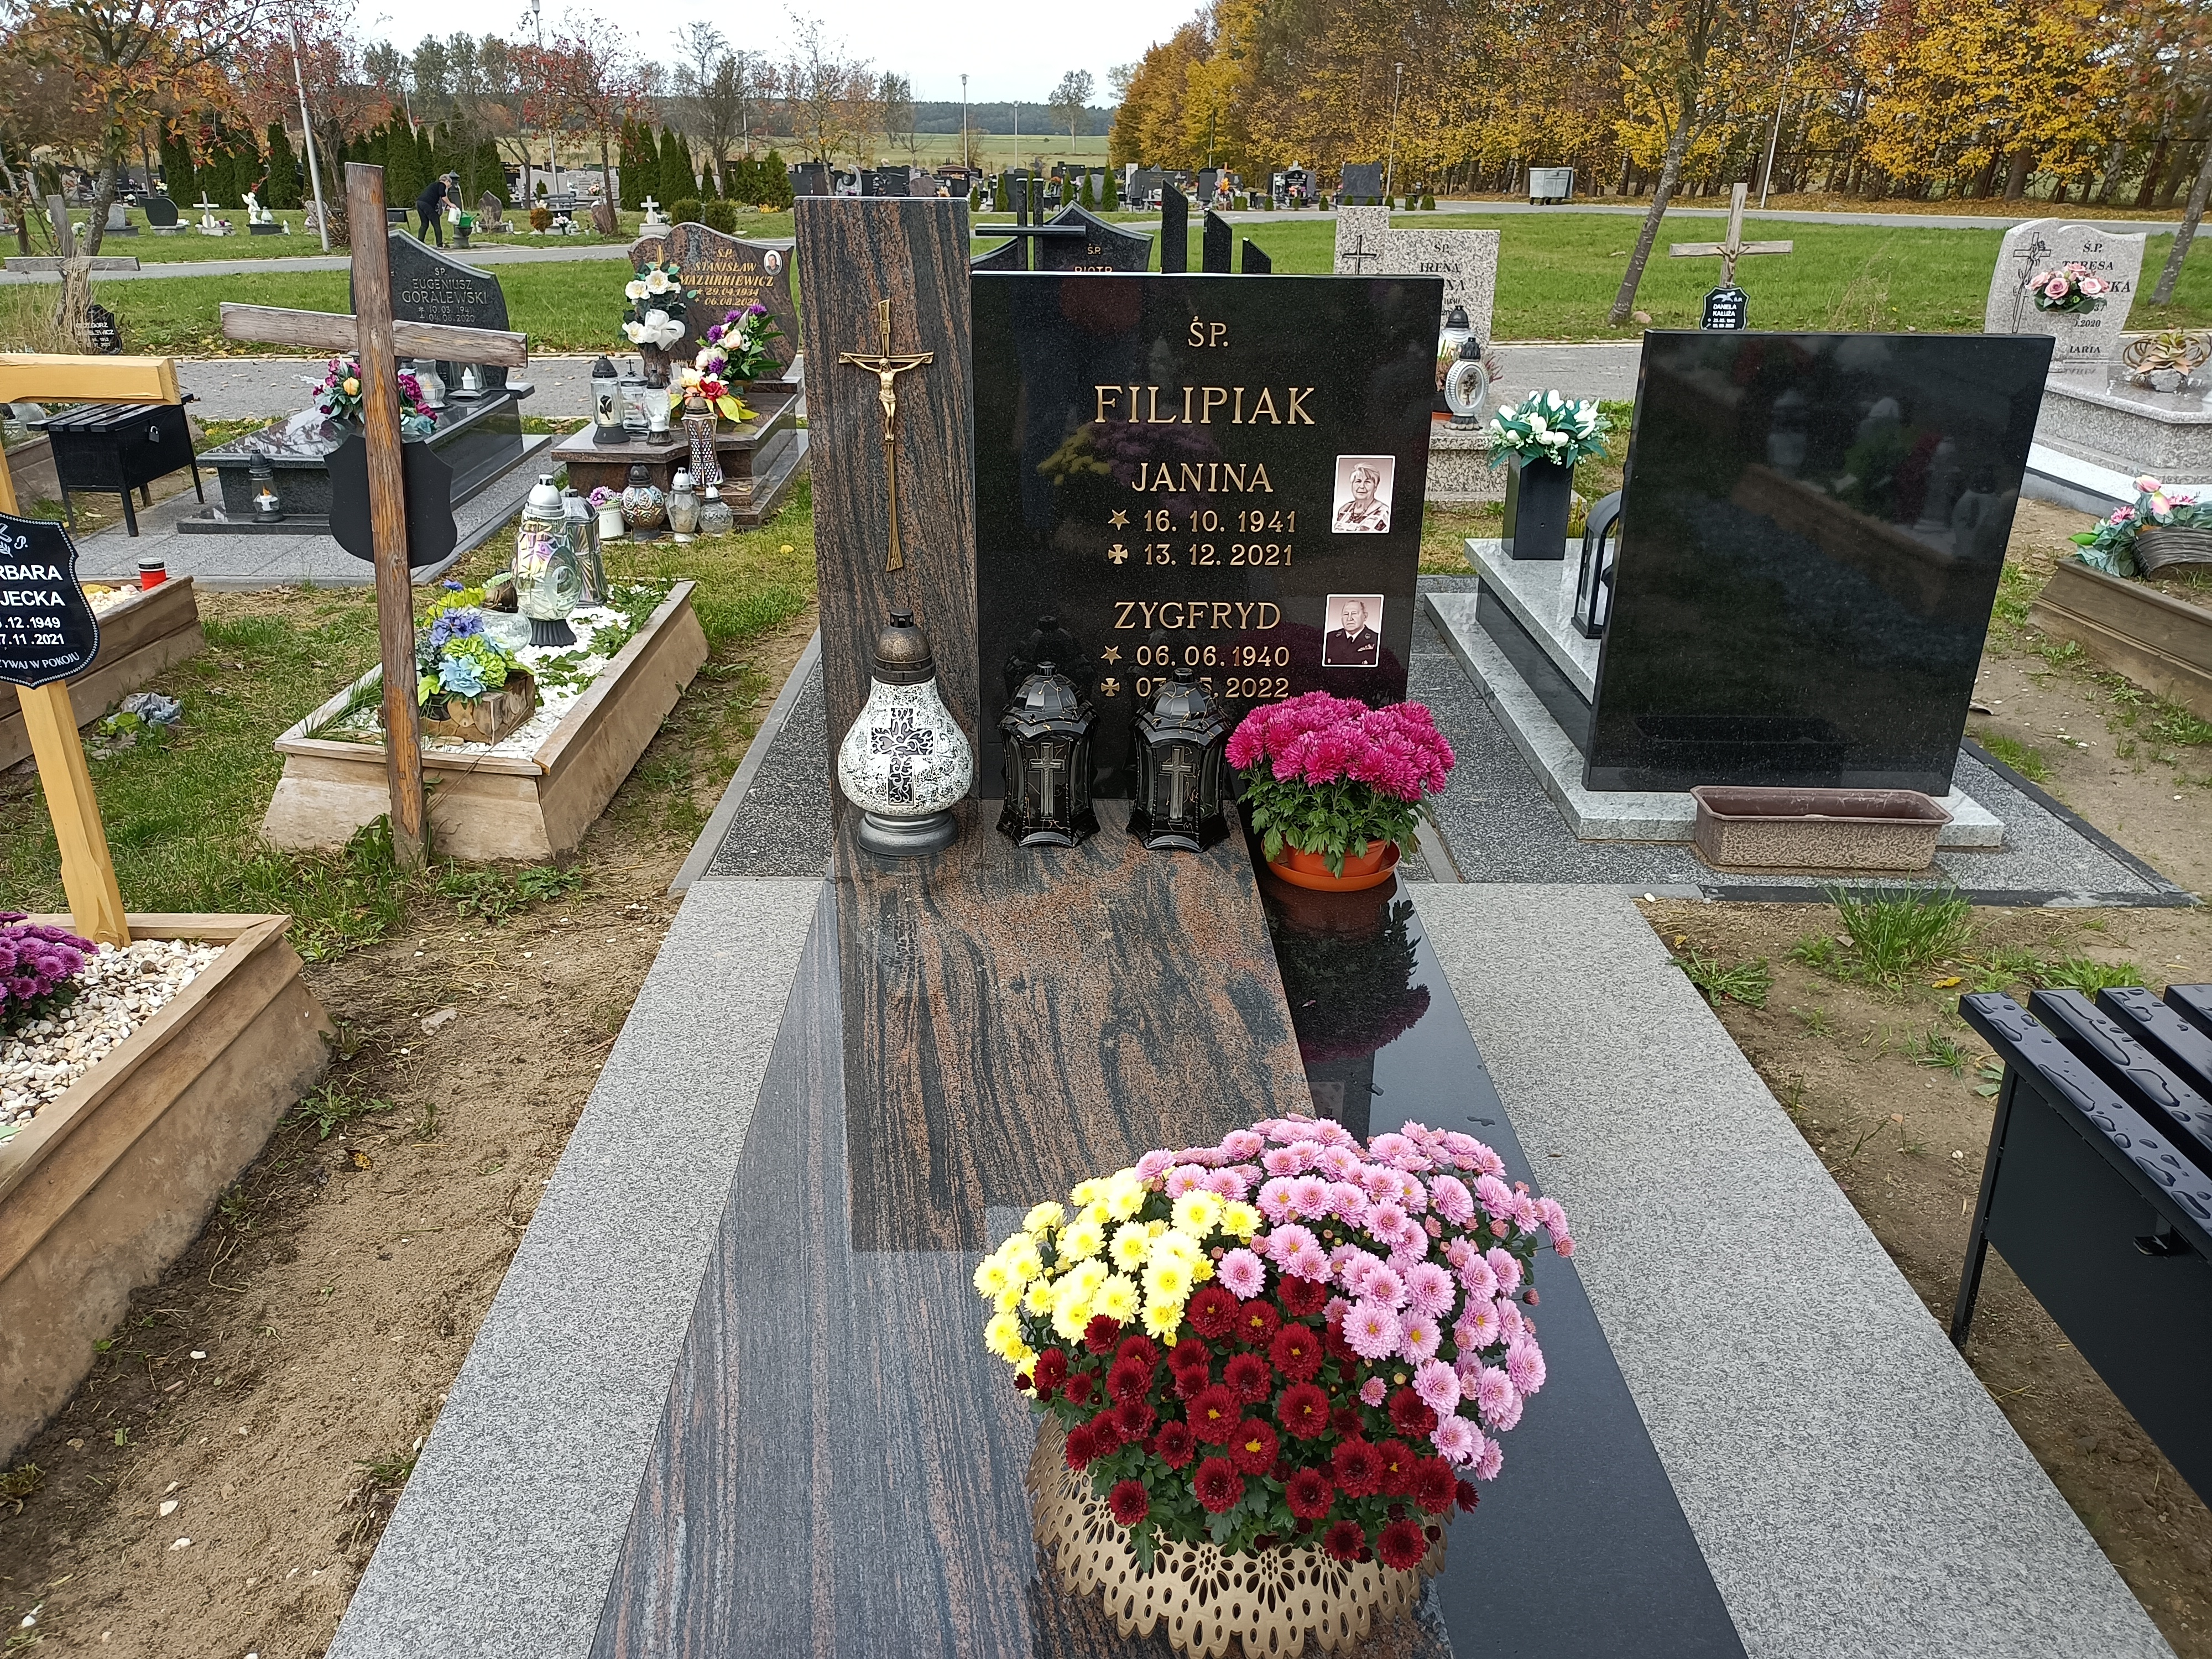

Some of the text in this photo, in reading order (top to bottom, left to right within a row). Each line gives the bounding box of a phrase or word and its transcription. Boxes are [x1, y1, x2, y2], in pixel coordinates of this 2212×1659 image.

[695, 262, 757, 272] STANISŁAW
[1420, 262, 1461, 273] IRENA
[412, 278, 472, 290] EUGENIUSZ
[679, 274, 774, 287] MAZURKIEWICZ
[1188, 315, 1228, 347] ŚP.
[1094, 385, 1316, 425] FILIPIAK
[1131, 462, 1274, 492] JANINA
[1114, 602, 1281, 629] ZYGFRYD
[42, 651, 80, 669] POKOJU
